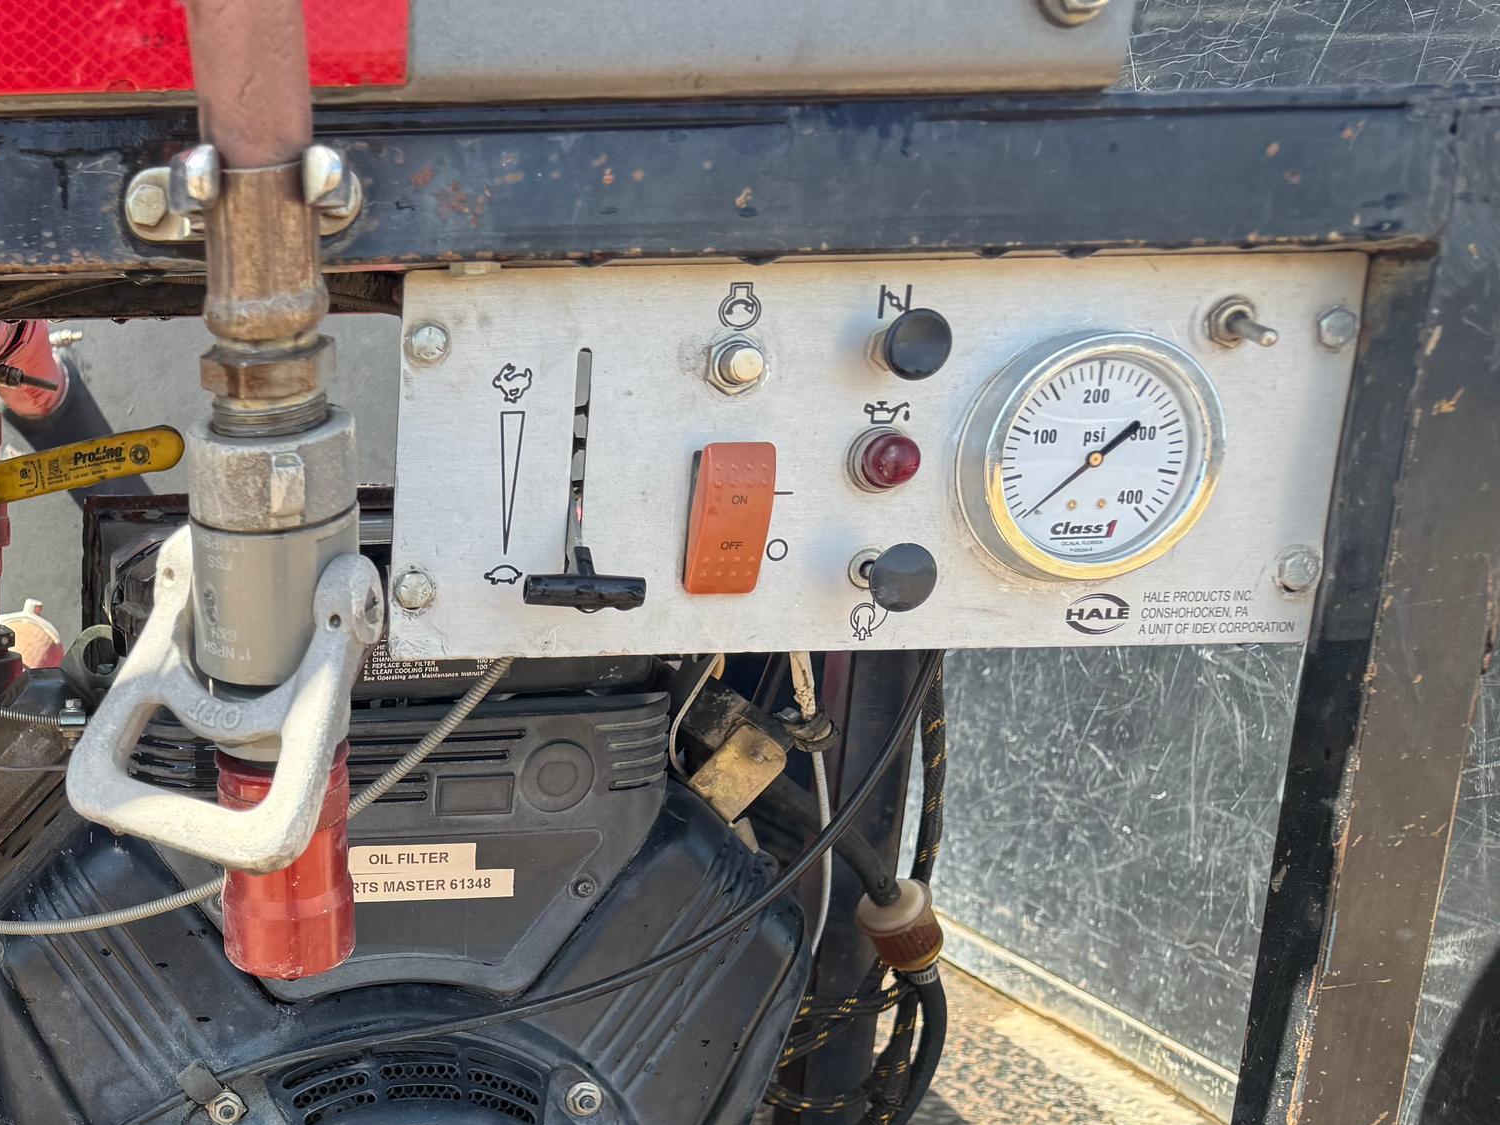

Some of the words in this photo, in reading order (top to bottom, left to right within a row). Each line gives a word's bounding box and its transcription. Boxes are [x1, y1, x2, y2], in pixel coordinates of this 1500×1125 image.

[1083, 388, 1110, 404] 200
[1033, 429, 1057, 444] 100
[1083, 427, 1106, 446] psi
[731, 495, 748, 504] ON
[1117, 489, 1143, 504] 400
[720, 541, 744, 550] OFF
[1143, 591, 1170, 603] HALE
[1172, 590, 1231, 602] PRODUCTS
[1233, 590, 1253, 601] INC.
[1065, 607, 1130, 621] HALE
[1140, 607, 1233, 619] CONSHOHOCKEN,
[1235, 606, 1248, 617] PA
[1138, 625, 1146, 635] A
[1148, 624, 1172, 635] UNIT
[1174, 624, 1189, 634] OF
[1192, 623, 1217, 634] IDEX
[1218, 621, 1295, 633] CORPORATION
[368, 854, 393, 865] OIL
[397, 852, 449, 864] FILTER
[352, 881, 378, 893] RTS
[383, 879, 445, 893] MASTER
[450, 877, 491, 889] 61348
